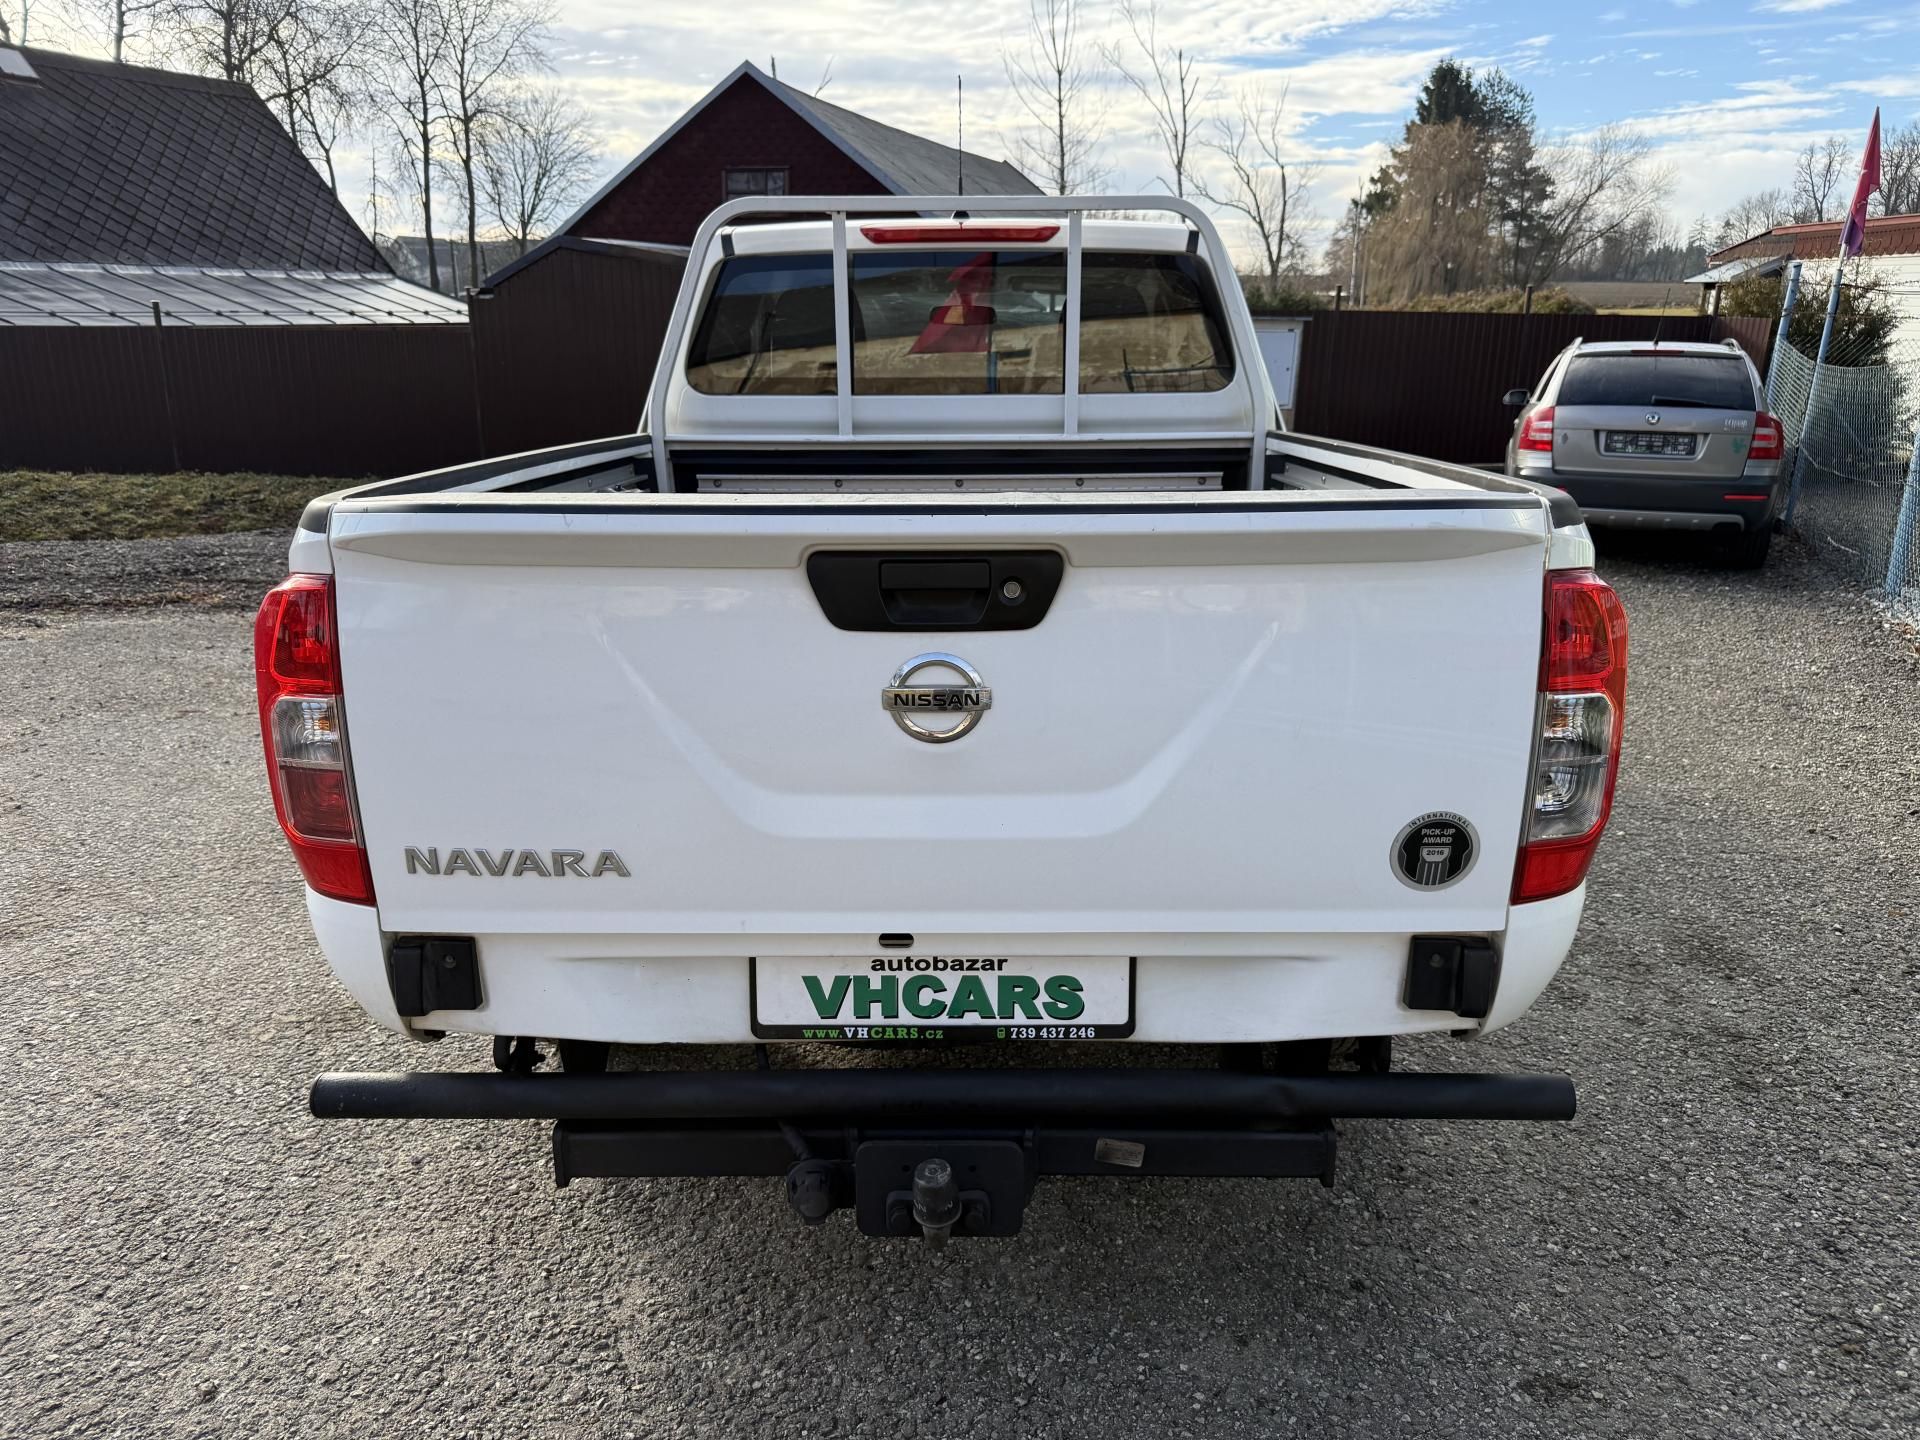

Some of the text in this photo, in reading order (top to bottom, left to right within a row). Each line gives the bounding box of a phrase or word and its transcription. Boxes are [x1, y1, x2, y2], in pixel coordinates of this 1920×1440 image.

[893, 693, 980, 707] NISSAN
[1409, 812, 1470, 828] INTERNATIONAL
[1421, 828, 1456, 836] PICK-UP
[1422, 836, 1453, 844] AWARD
[404, 846, 632, 877] NAVARA
[871, 956, 1008, 972] autobazar
[801, 974, 1085, 1020] VHCARS
[802, 1027, 944, 1039] www.VHCARS.cz
[1010, 1027, 1096, 1039] 739 437 246
